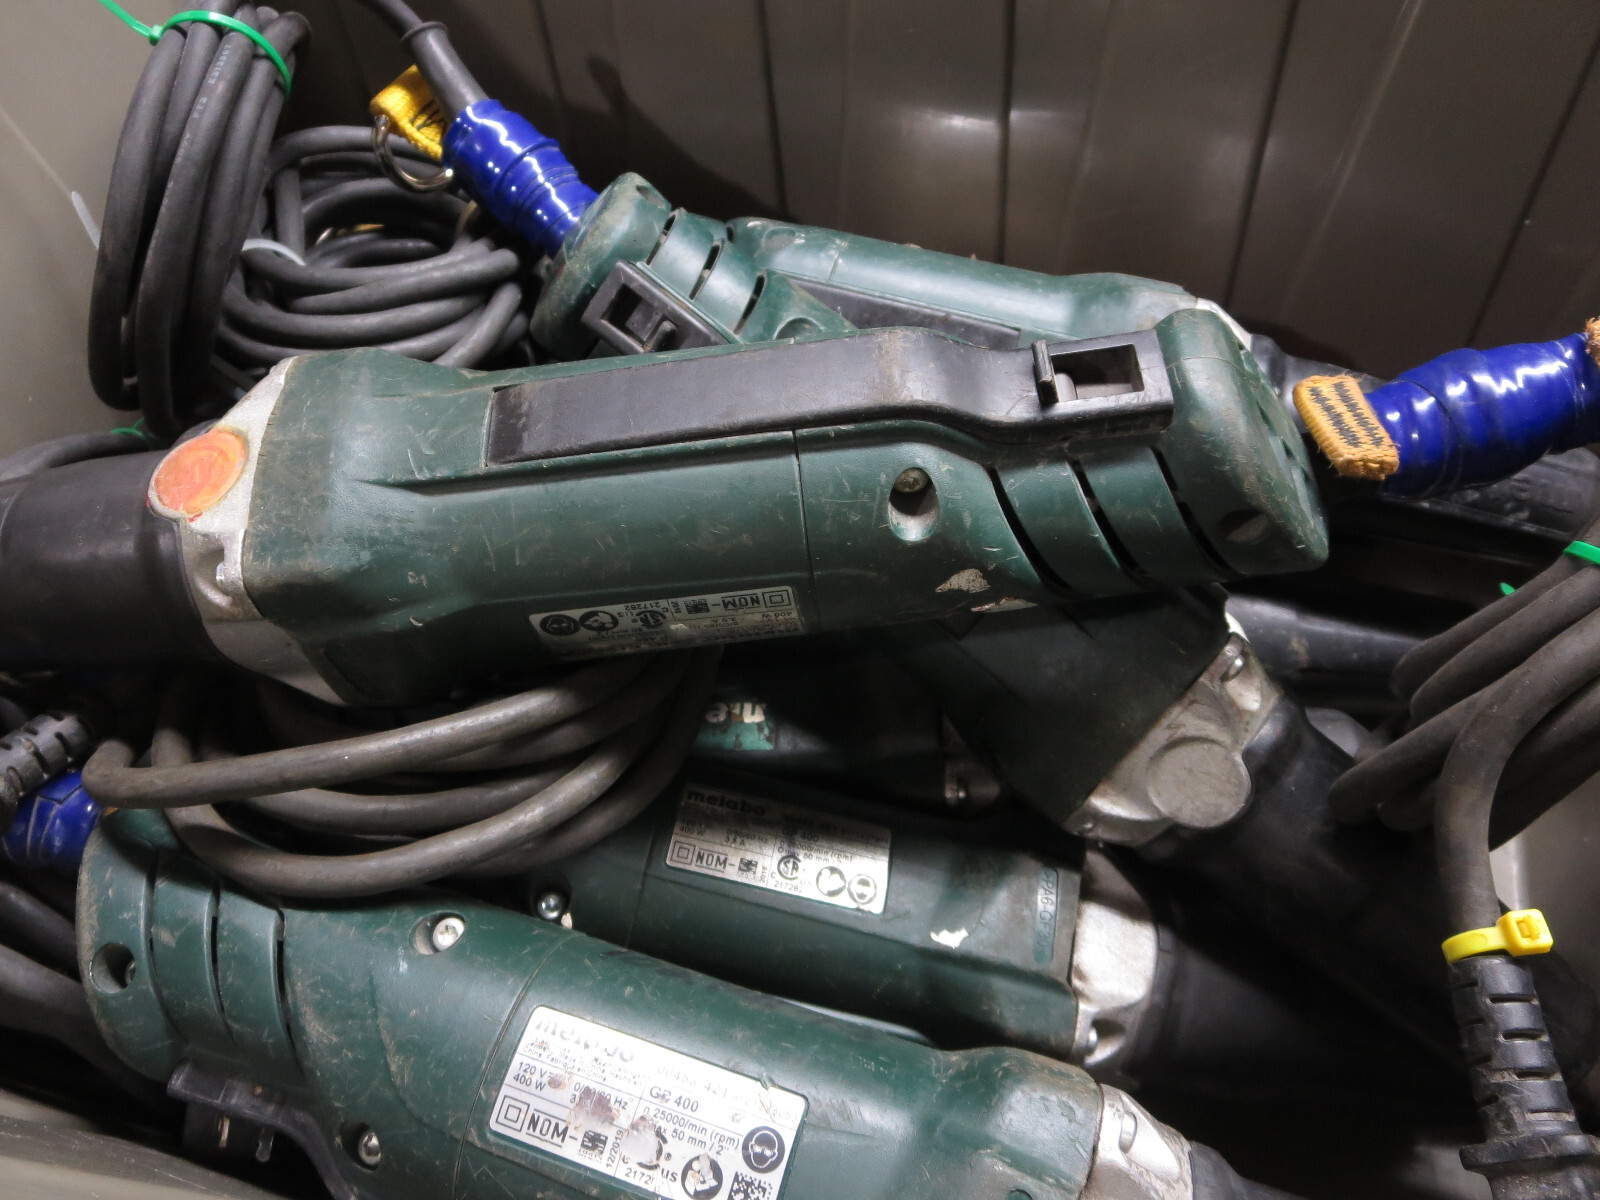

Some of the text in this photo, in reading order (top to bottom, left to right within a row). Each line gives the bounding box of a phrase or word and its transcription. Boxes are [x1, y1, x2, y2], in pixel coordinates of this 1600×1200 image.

[687, 790, 766, 816] metabo
[679, 826, 695, 835] 400
[511, 1072, 546, 1092] 400 W
[517, 1060, 537, 1075] 120
[613, 1096, 629, 1110] Hz
[672, 1093, 700, 1113] 400
[651, 1107, 710, 1137] 25000/min
[708, 1128, 742, 1149] (rpm)
[670, 1127, 685, 1141] 50
[686, 1133, 708, 1149] mm
[605, 1129, 624, 1169] 12/2019
